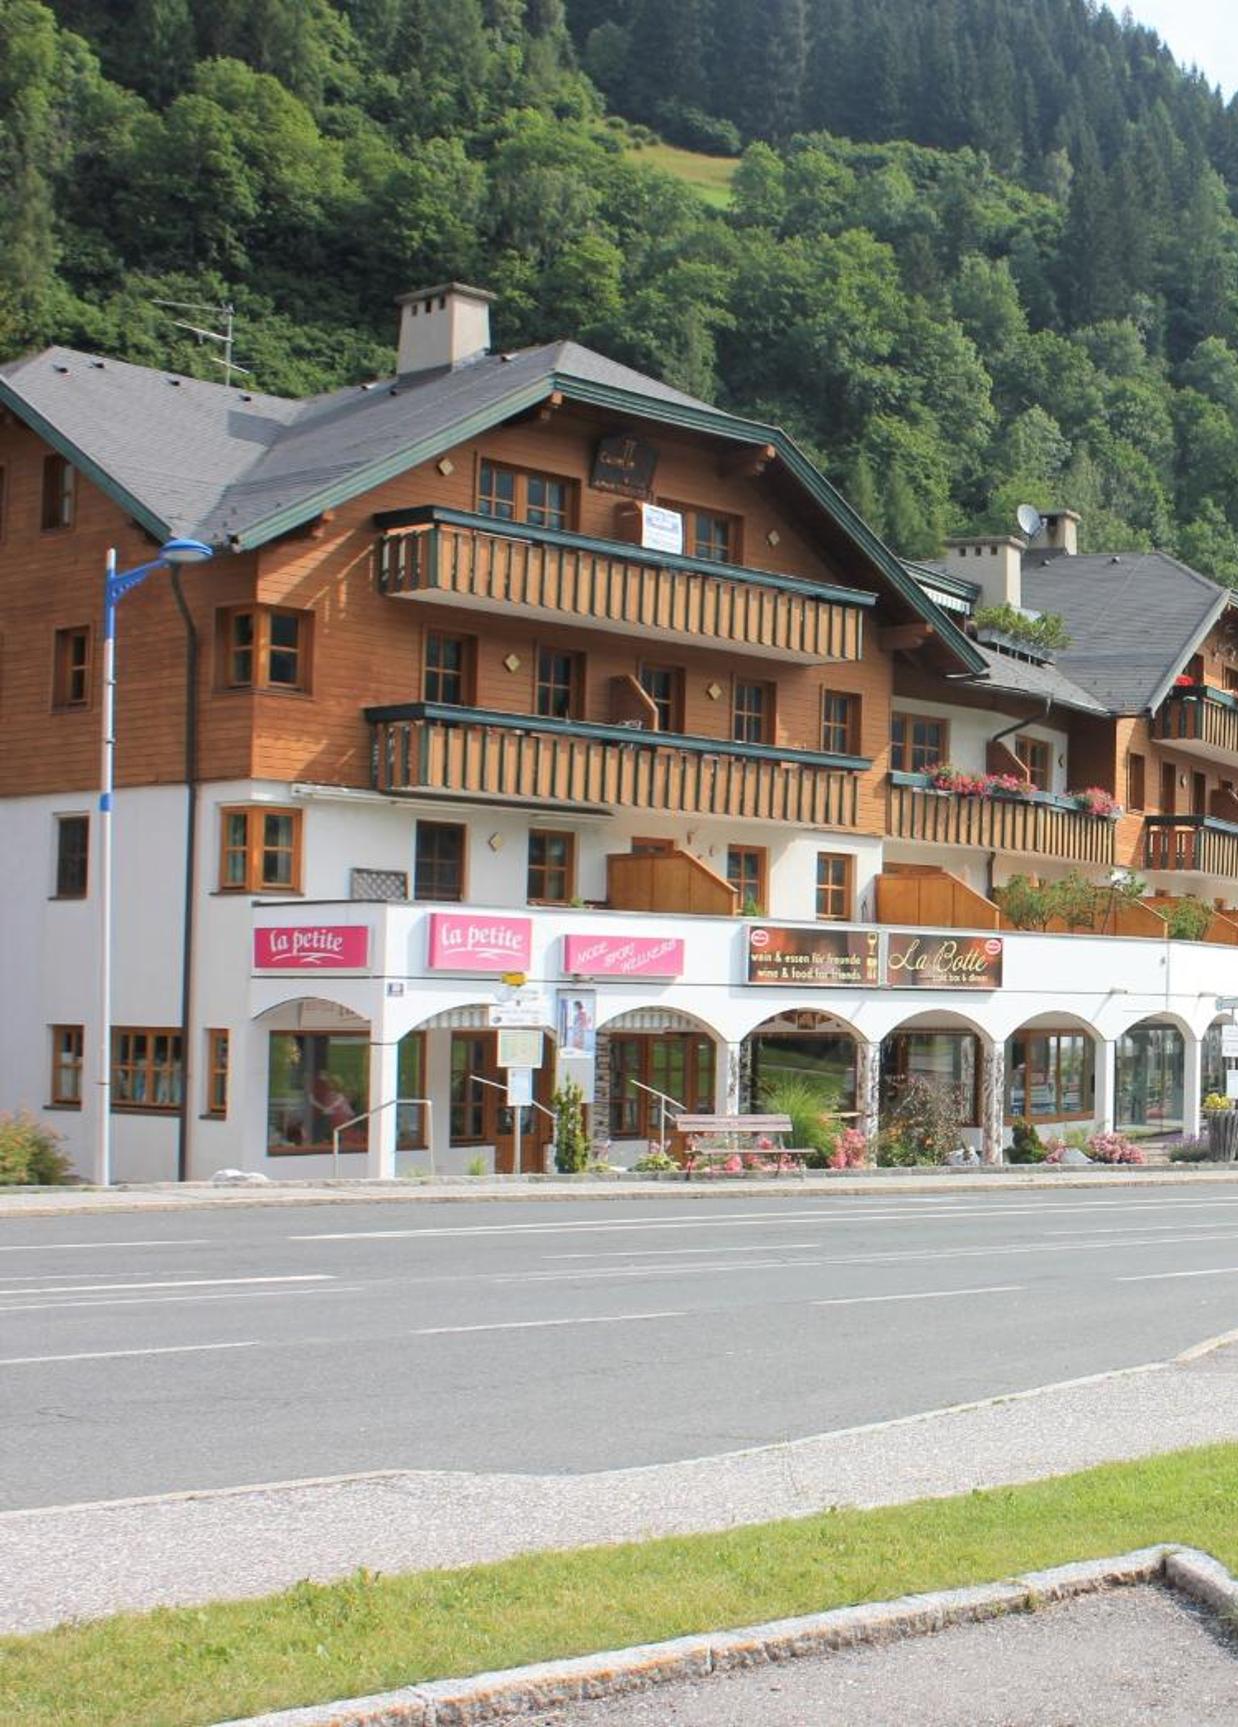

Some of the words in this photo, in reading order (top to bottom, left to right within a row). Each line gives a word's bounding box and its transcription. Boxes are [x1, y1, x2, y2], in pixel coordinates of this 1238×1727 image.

[270, 929, 289, 952] la
[292, 928, 344, 956] petite
[441, 922, 462, 946] la
[466, 924, 525, 951] petite
[888, 938, 928, 970] La
